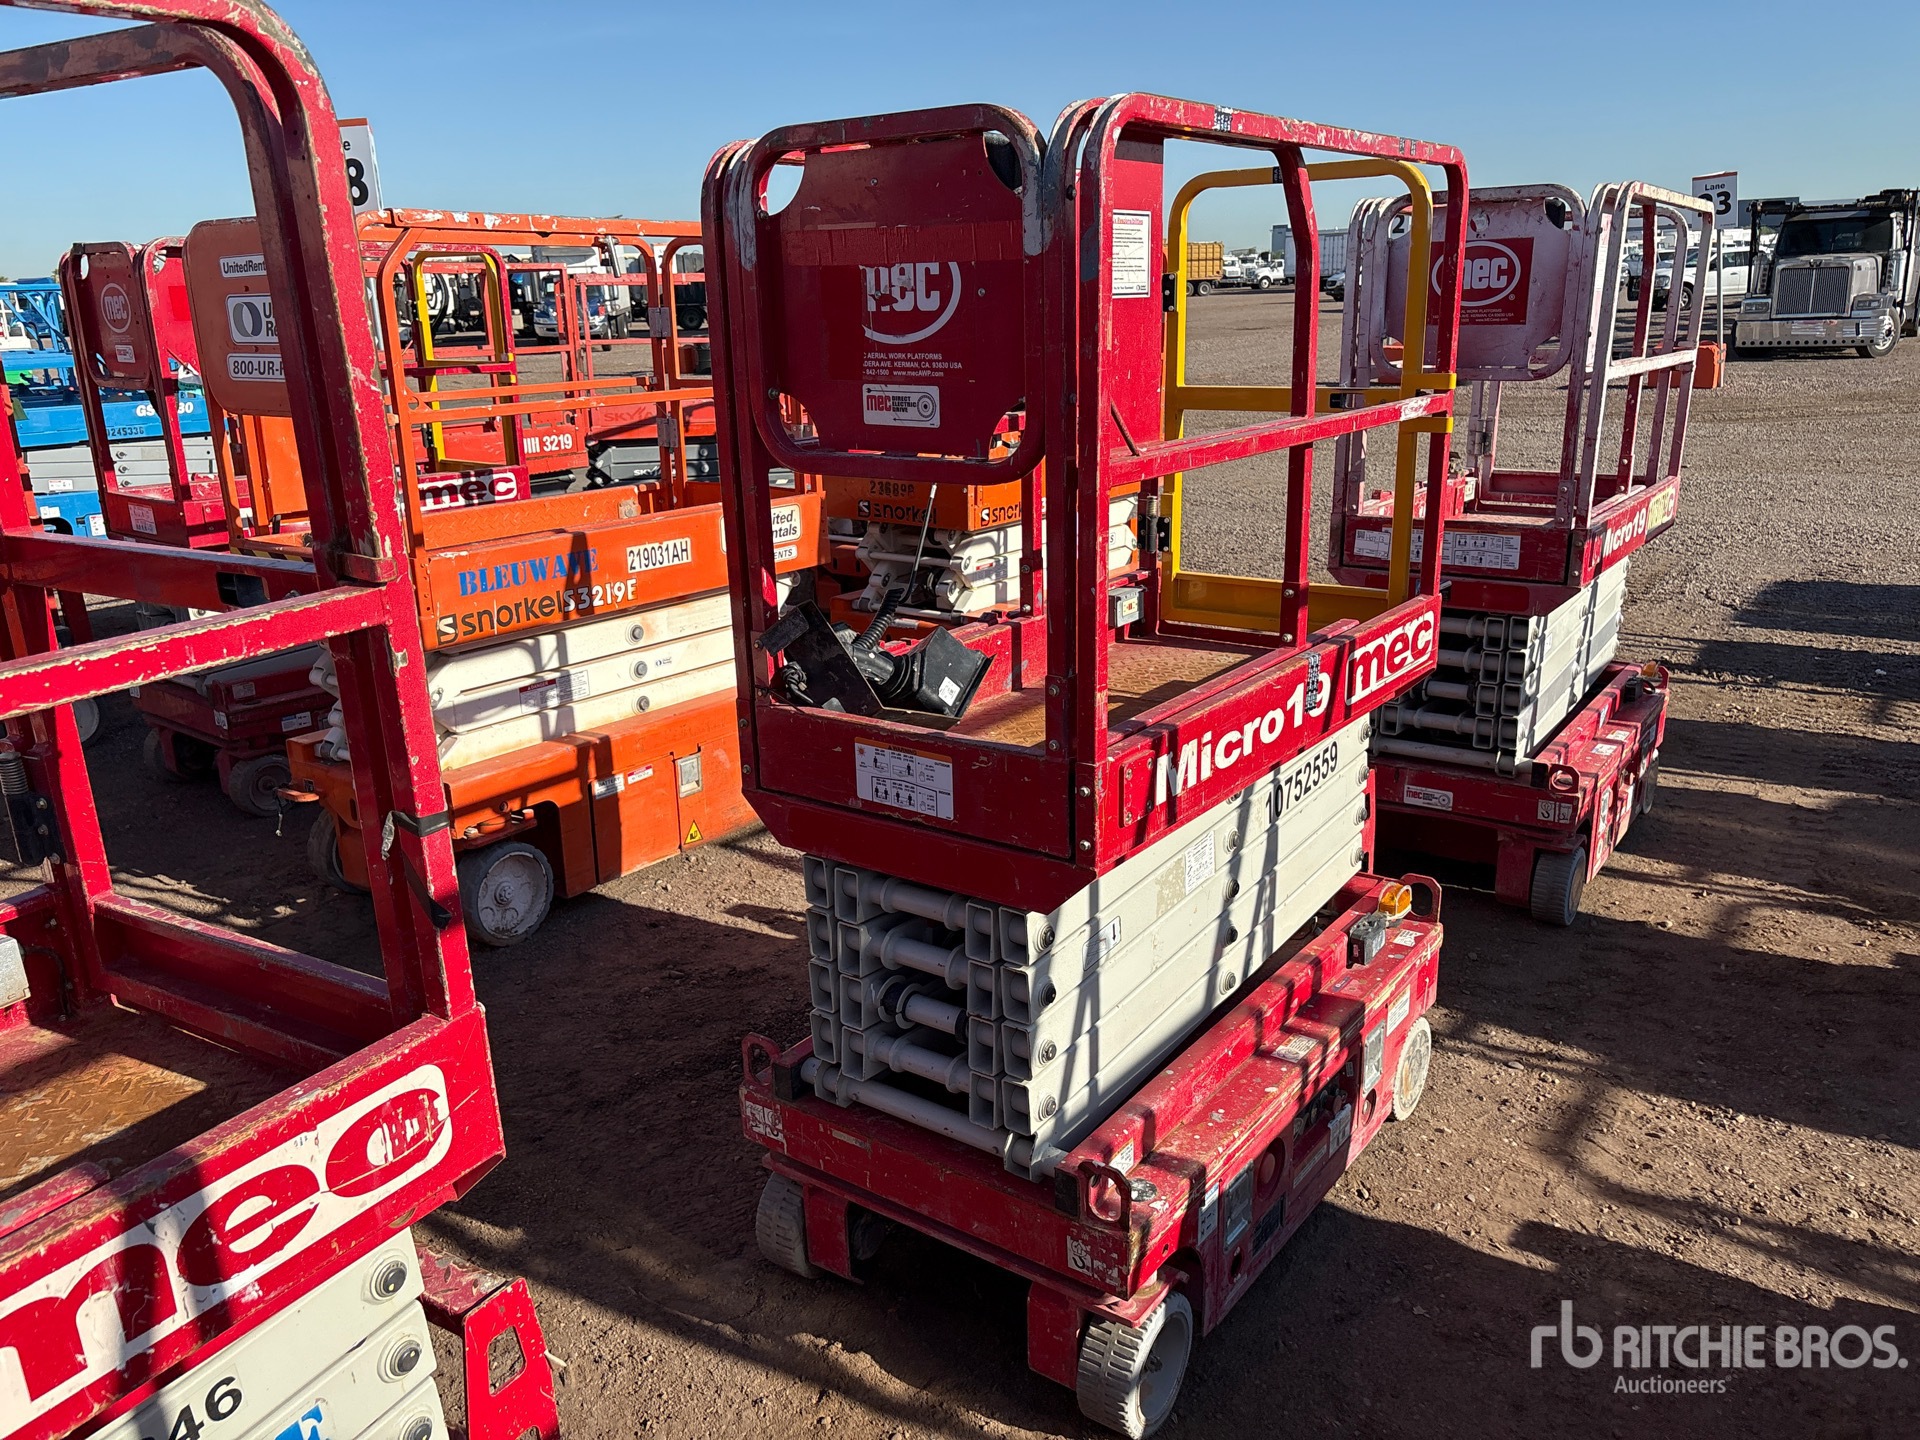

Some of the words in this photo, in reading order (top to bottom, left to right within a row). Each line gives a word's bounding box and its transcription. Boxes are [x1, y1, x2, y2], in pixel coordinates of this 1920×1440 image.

[104, 295, 128, 320] mec
[867, 352, 888, 360] AERIAL
[888, 352, 906, 360] WORK
[866, 394, 892, 412] mec
[543, 433, 573, 452] 3219
[419, 477, 517, 508] mec
[628, 540, 690, 571] 219031AH
[458, 548, 599, 597] BLEUWAVE
[462, 591, 565, 637] snorkel
[563, 578, 638, 612] S3219E
[1352, 616, 1432, 700] mec
[1265, 740, 1339, 825] 10752559
[1406, 790, 1423, 800] mec
